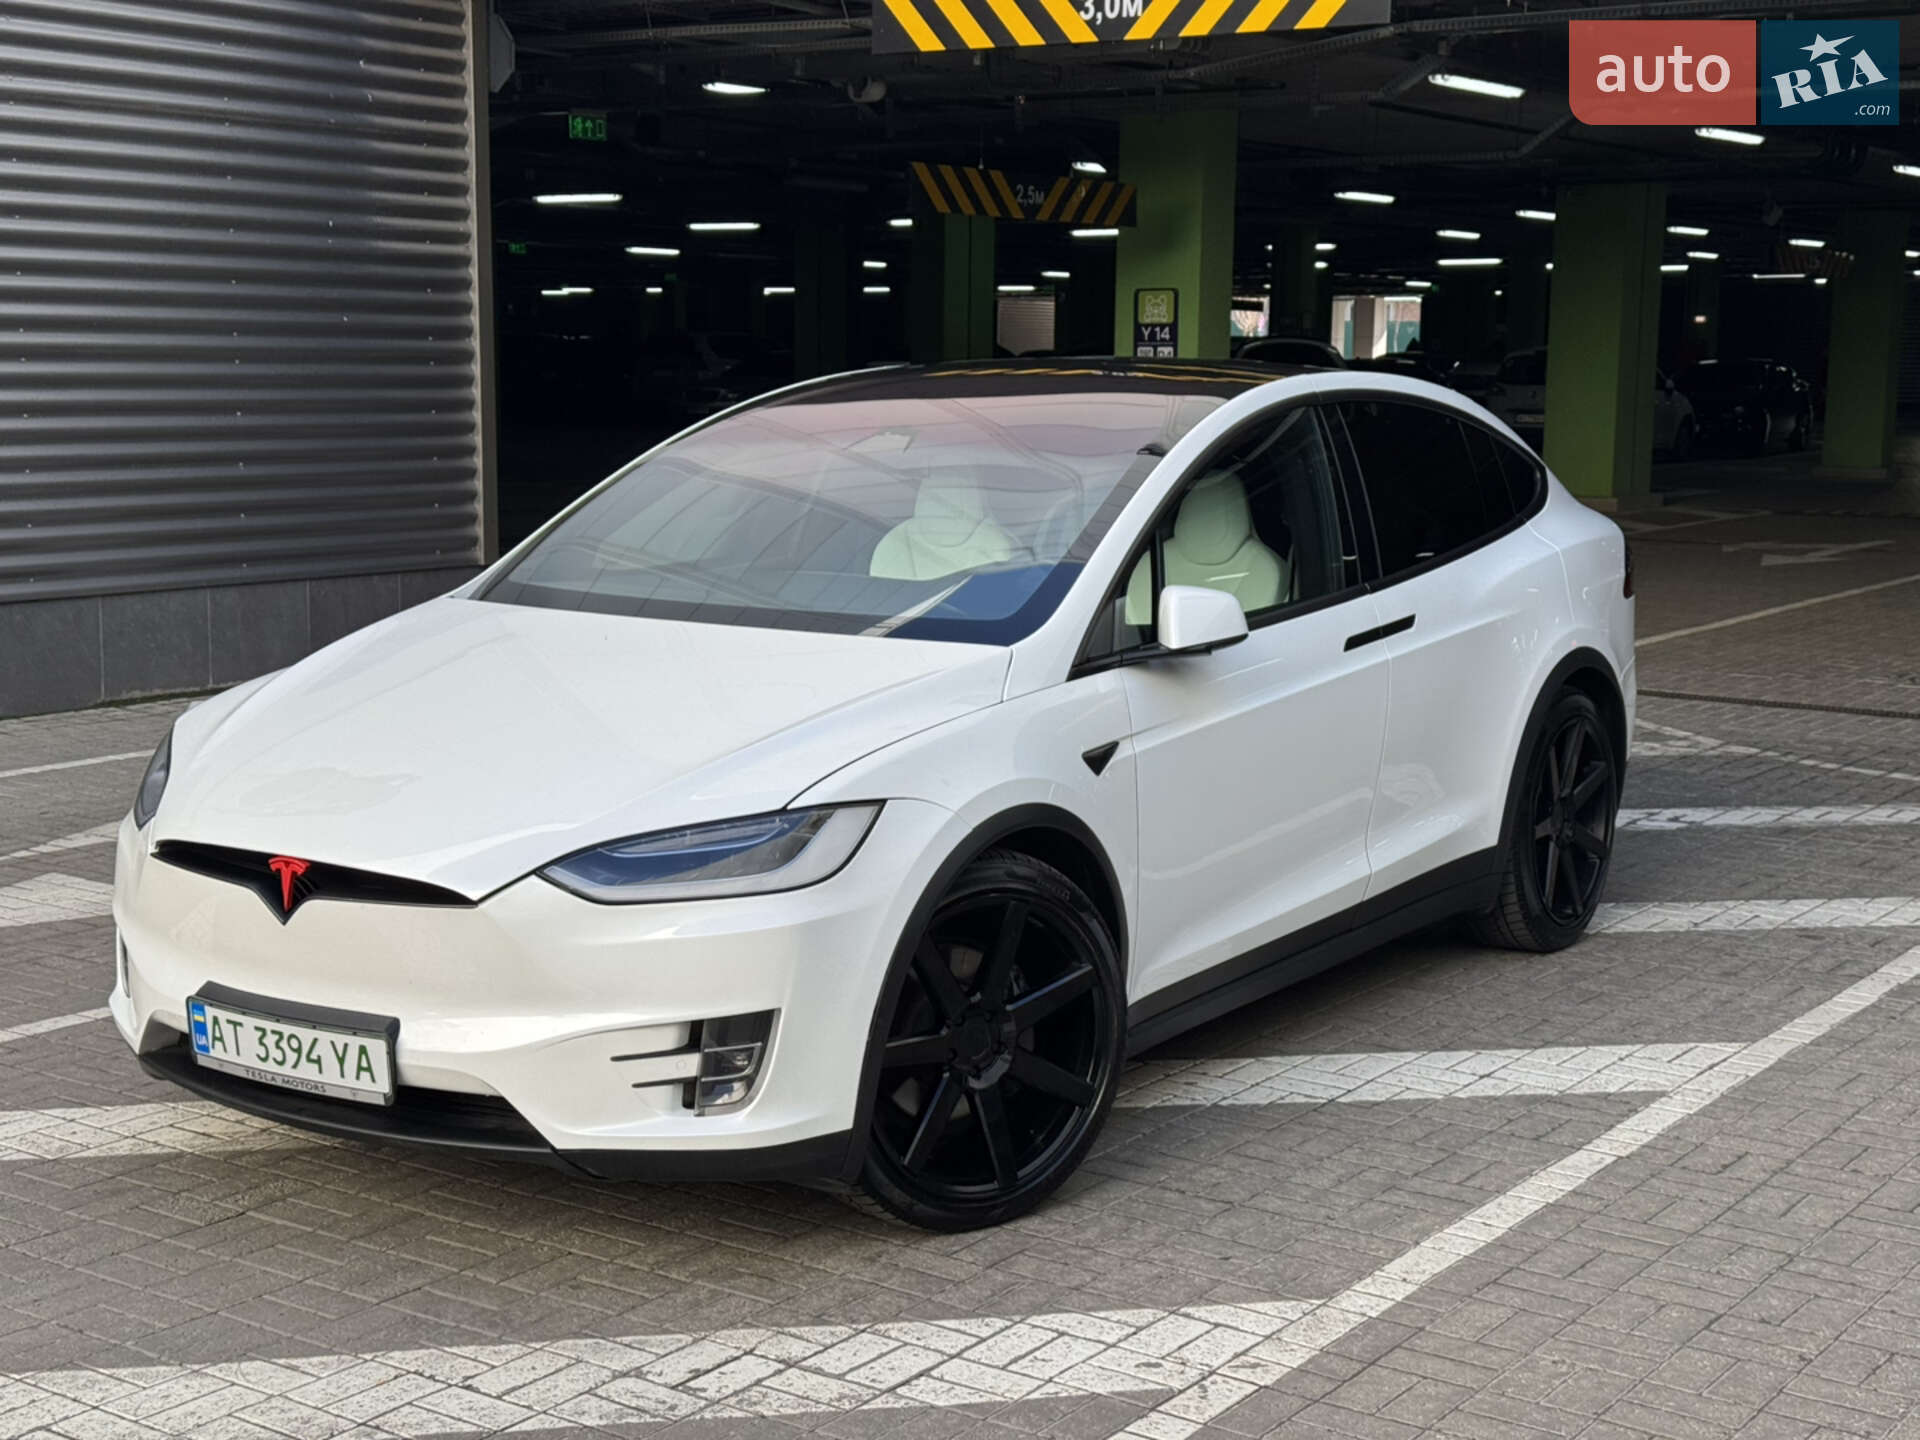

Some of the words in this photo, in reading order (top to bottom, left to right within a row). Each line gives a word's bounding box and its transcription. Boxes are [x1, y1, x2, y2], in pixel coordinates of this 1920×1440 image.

[1141, 326, 1151, 341] Y
[1154, 326, 1170, 341] 14
[196, 1032, 208, 1046] UA
[211, 1015, 244, 1057] AT
[253, 1026, 323, 1075] 3394
[329, 1039, 376, 1083] YA
[244, 1069, 277, 1084] TESLA
[281, 1078, 327, 1093] MOTORS
